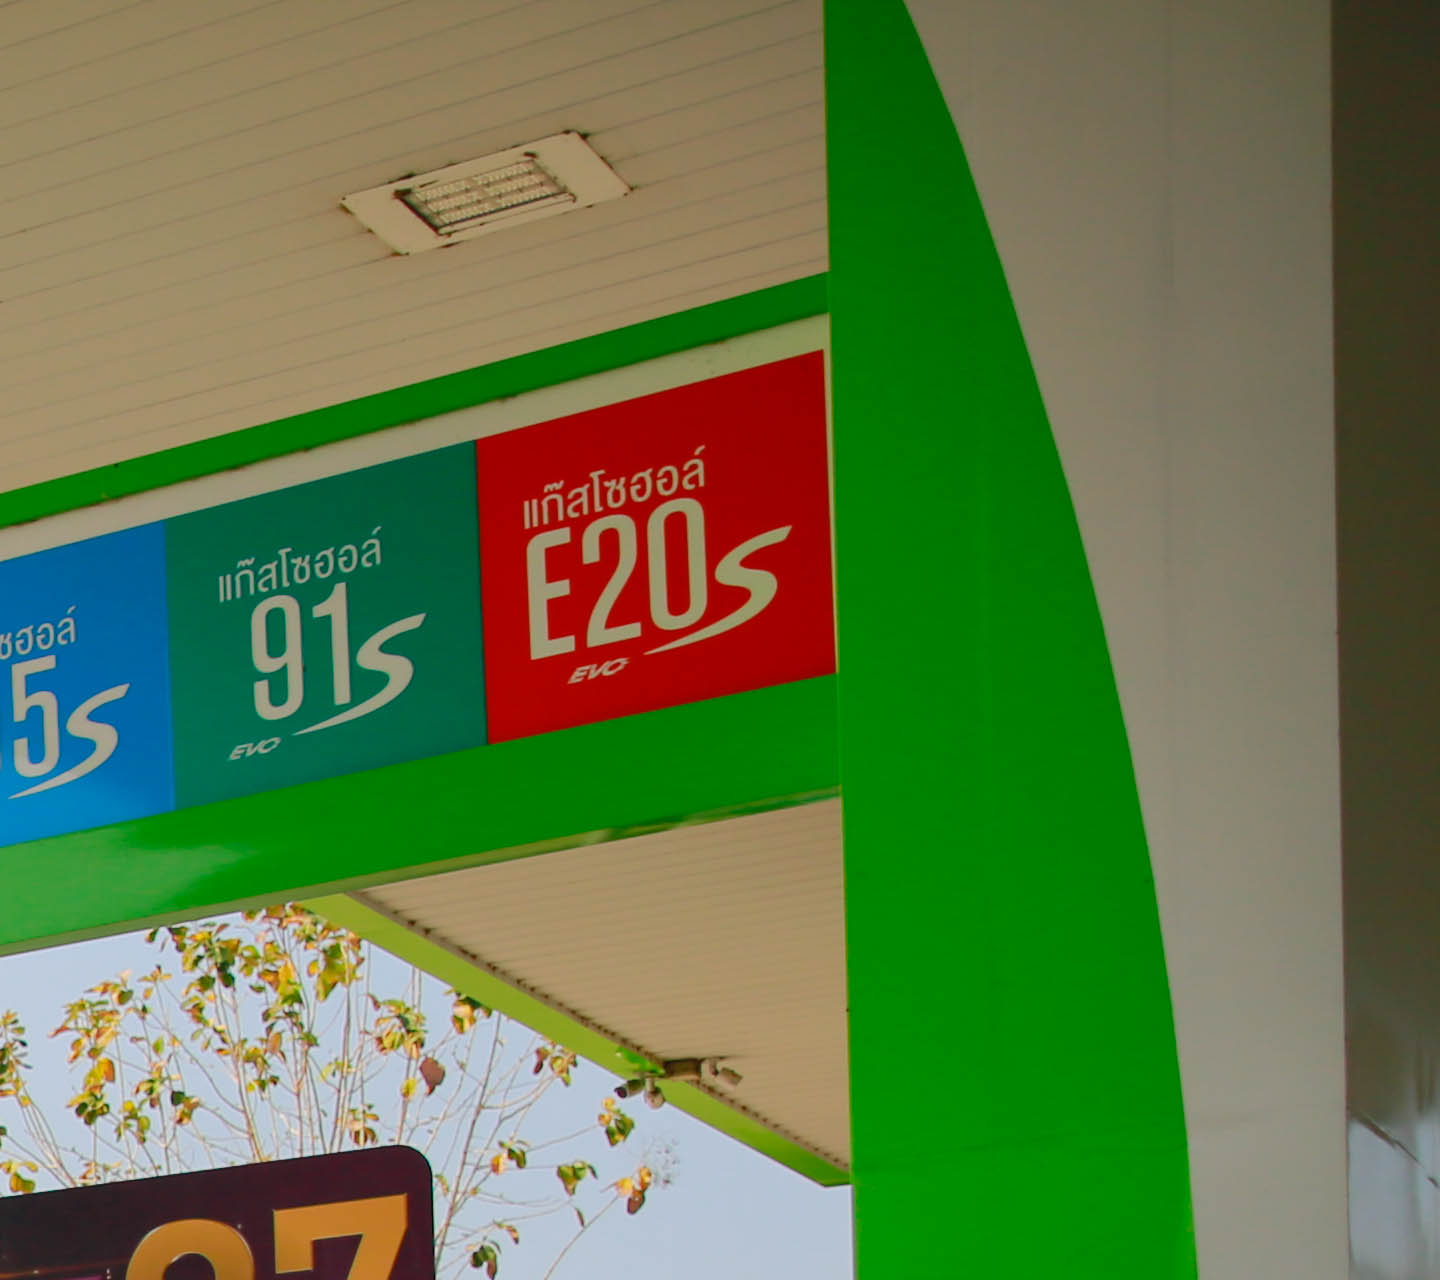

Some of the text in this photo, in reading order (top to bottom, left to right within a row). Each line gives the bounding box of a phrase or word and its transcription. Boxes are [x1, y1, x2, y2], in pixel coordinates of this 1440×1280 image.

[523, 445, 706, 530] แก๊สโซฮอล์
[218, 527, 382, 602] แก๊สโซฮอล์
[568, 658, 632, 684] EVO
[228, 736, 282, 762] EVO
